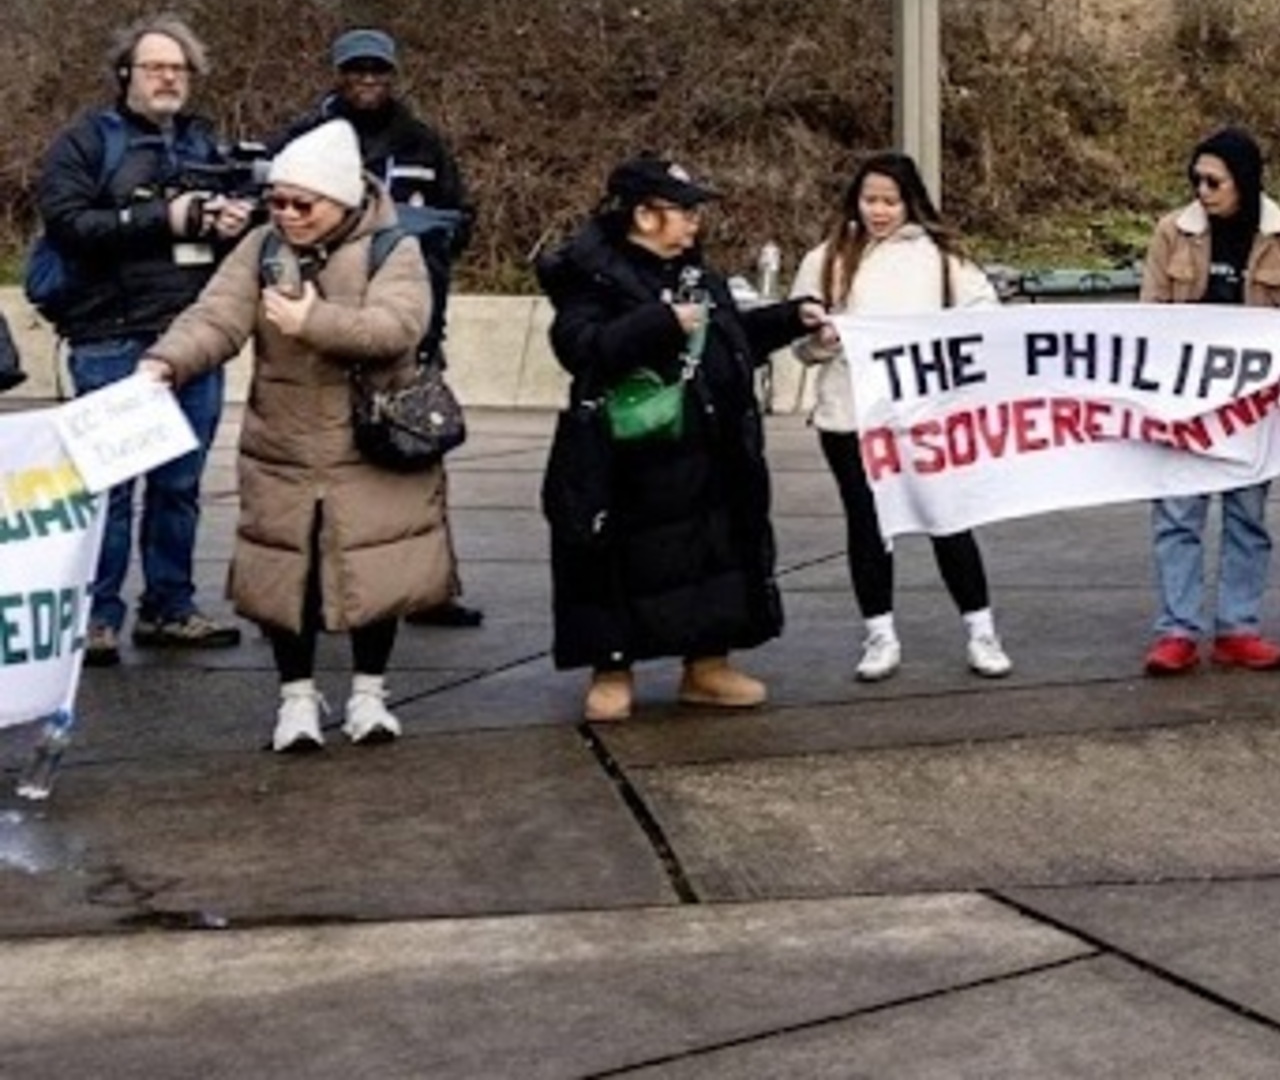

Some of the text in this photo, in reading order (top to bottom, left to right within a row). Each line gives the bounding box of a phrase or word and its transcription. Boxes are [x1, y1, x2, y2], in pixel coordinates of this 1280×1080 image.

[871, 333, 987, 401] THE
[862, 426, 902, 481] A
[910, 397, 1214, 475] SOVEREIGN
